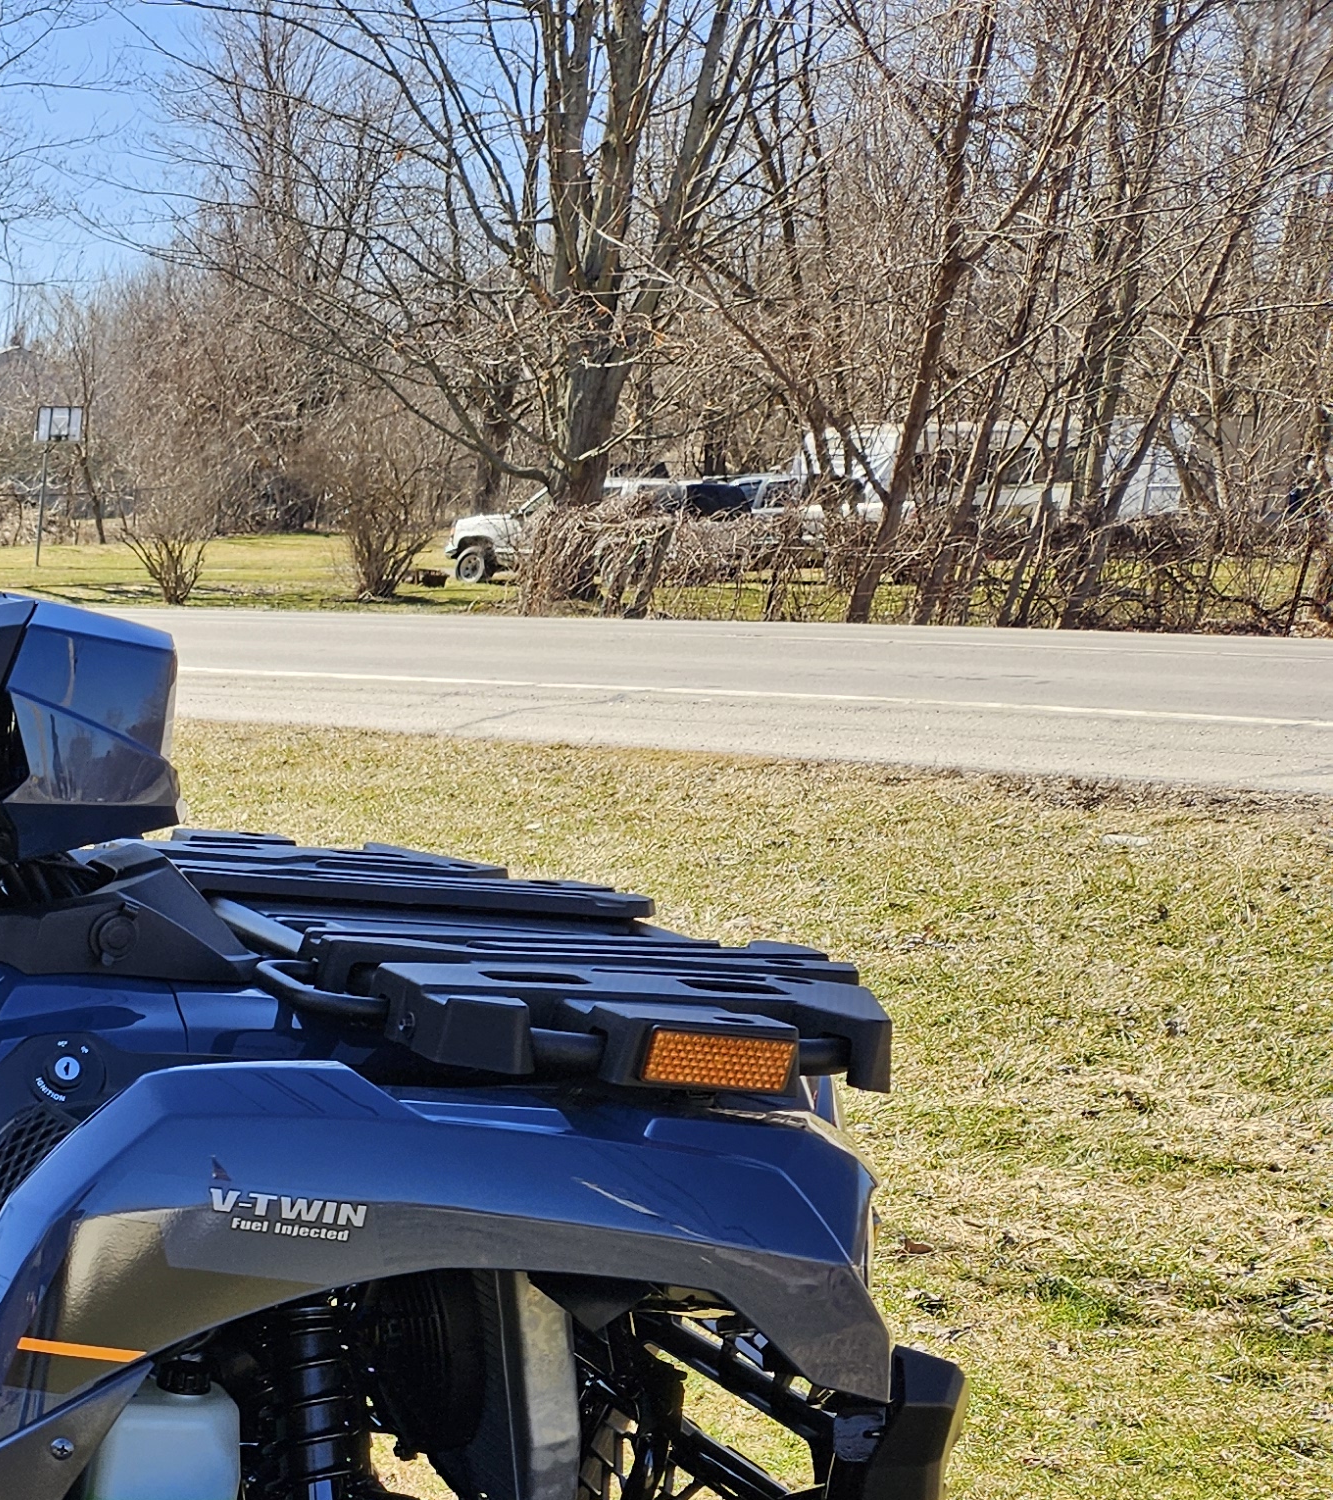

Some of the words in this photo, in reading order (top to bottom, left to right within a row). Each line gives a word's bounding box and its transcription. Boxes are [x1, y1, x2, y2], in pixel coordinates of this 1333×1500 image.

[35, 1076, 67, 1102] IGNITION
[209, 1187, 368, 1228] V-TWIN
[231, 1217, 269, 1233] Fuel
[274, 1221, 349, 1242] Injected
